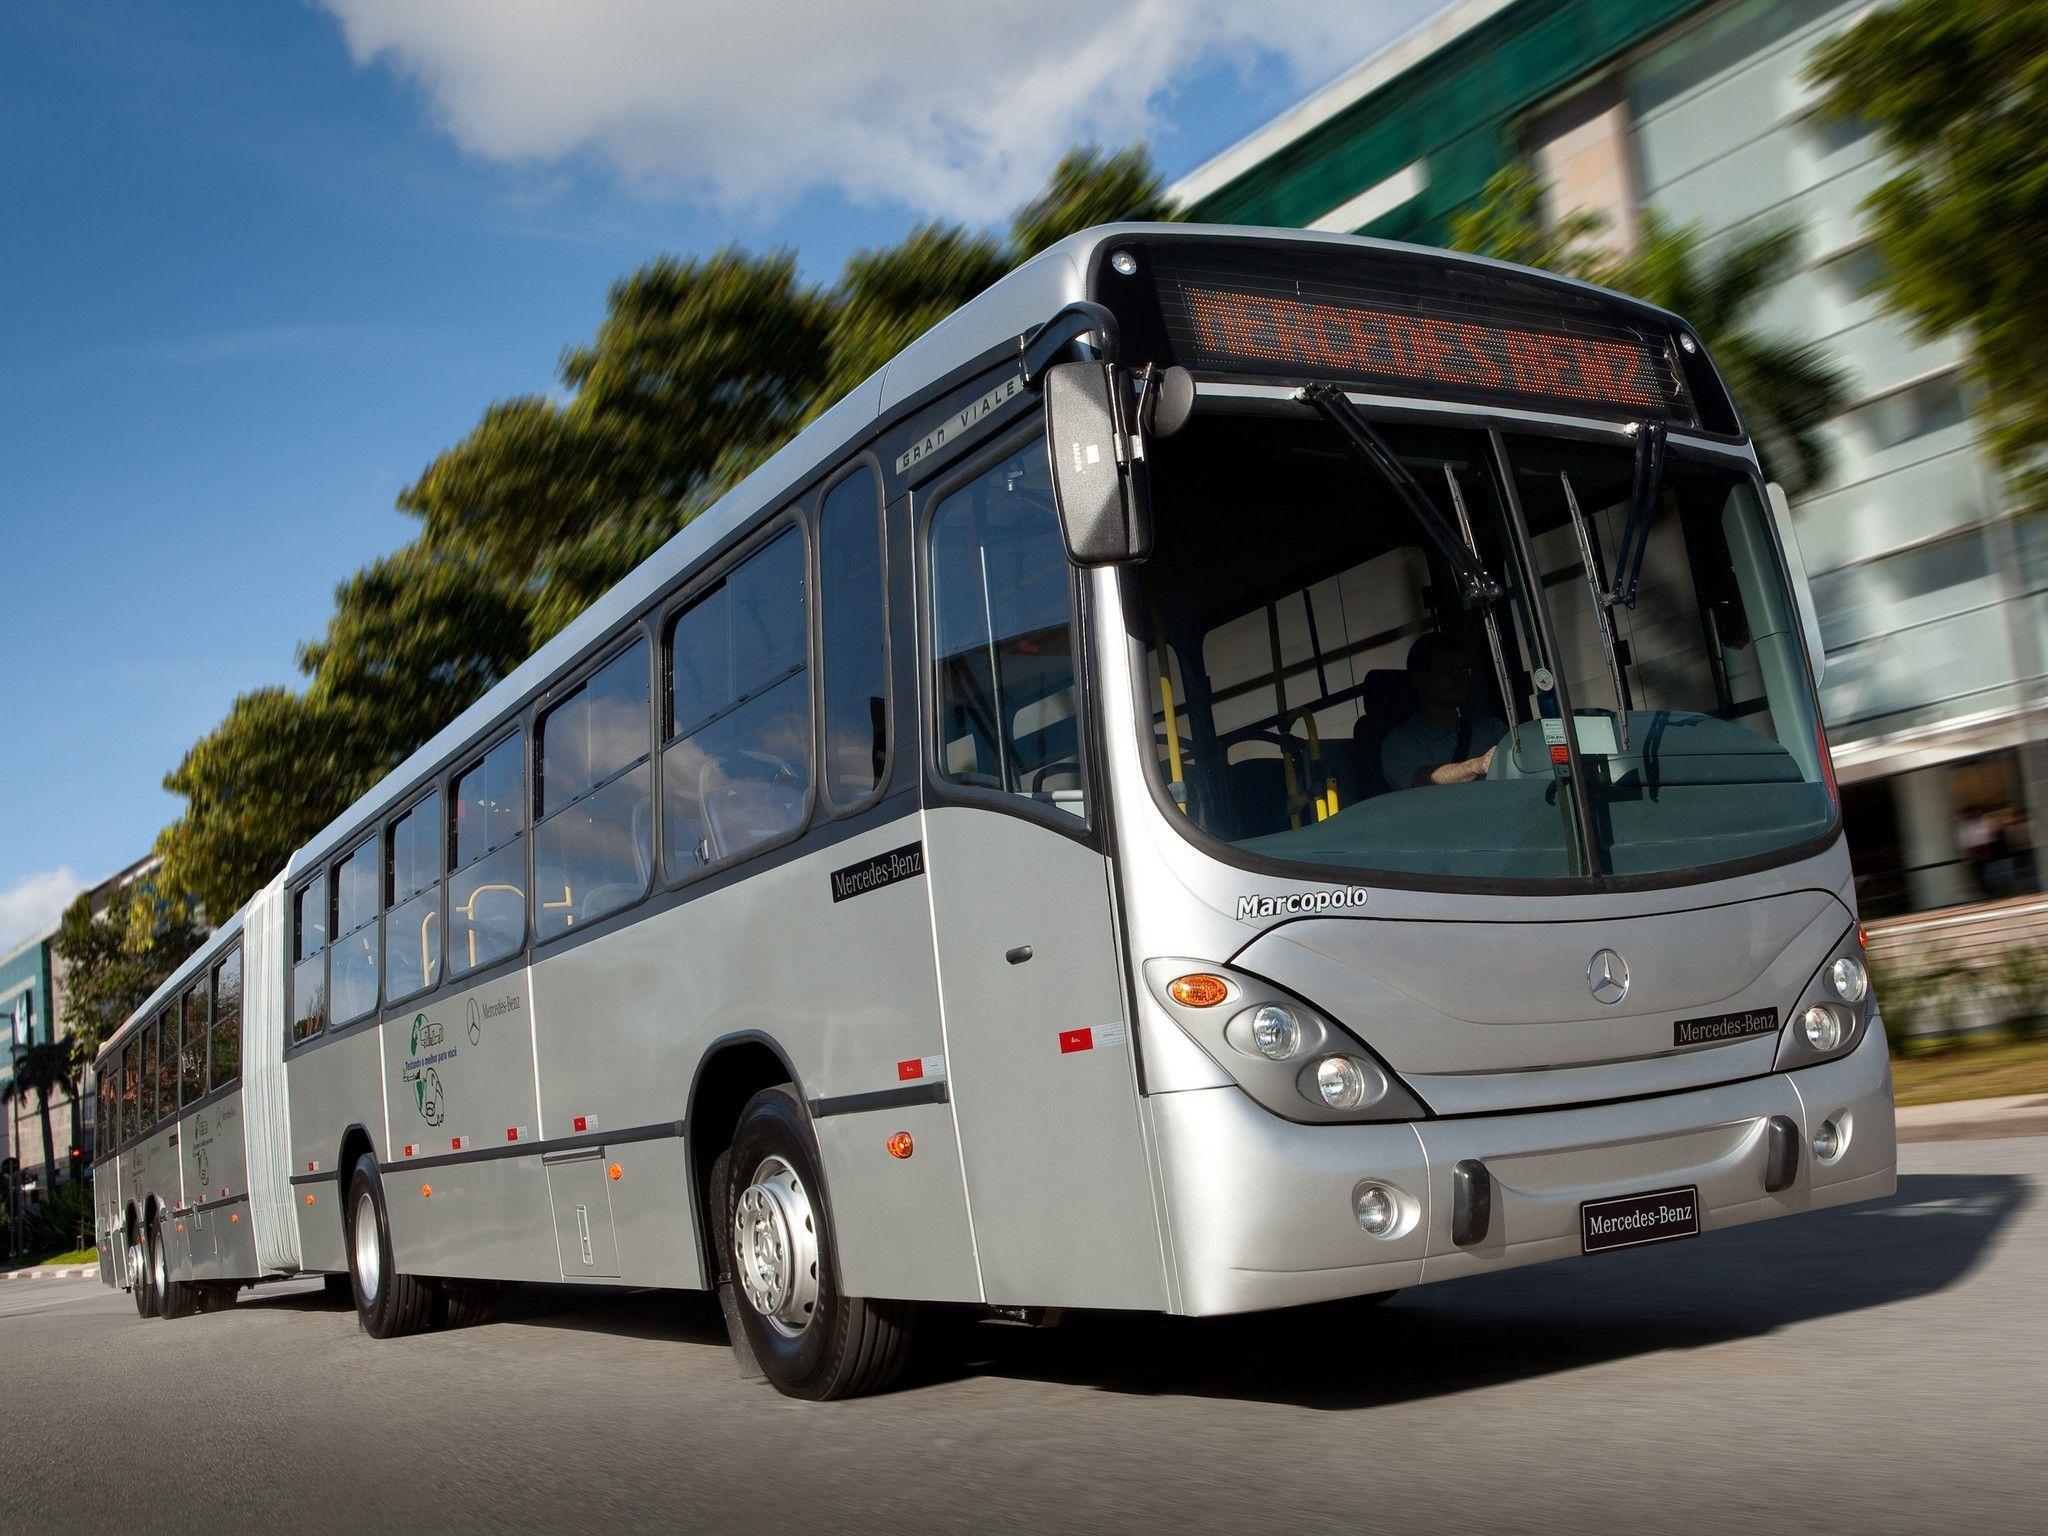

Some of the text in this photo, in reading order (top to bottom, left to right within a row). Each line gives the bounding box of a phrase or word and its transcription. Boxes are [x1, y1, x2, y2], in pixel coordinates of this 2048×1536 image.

[1190, 291, 1652, 406] MERCEDES BENZ
[960, 379, 1015, 428] VIALE
[834, 851, 921, 899] Mercedes-Benz
[1236, 884, 1369, 921] Marcopolo
[481, 994, 521, 1021] Mercedes-Benz
[1679, 1013, 1775, 1044] Mercedes-Benz
[1589, 1204, 1693, 1236] Mercedes-Benz
